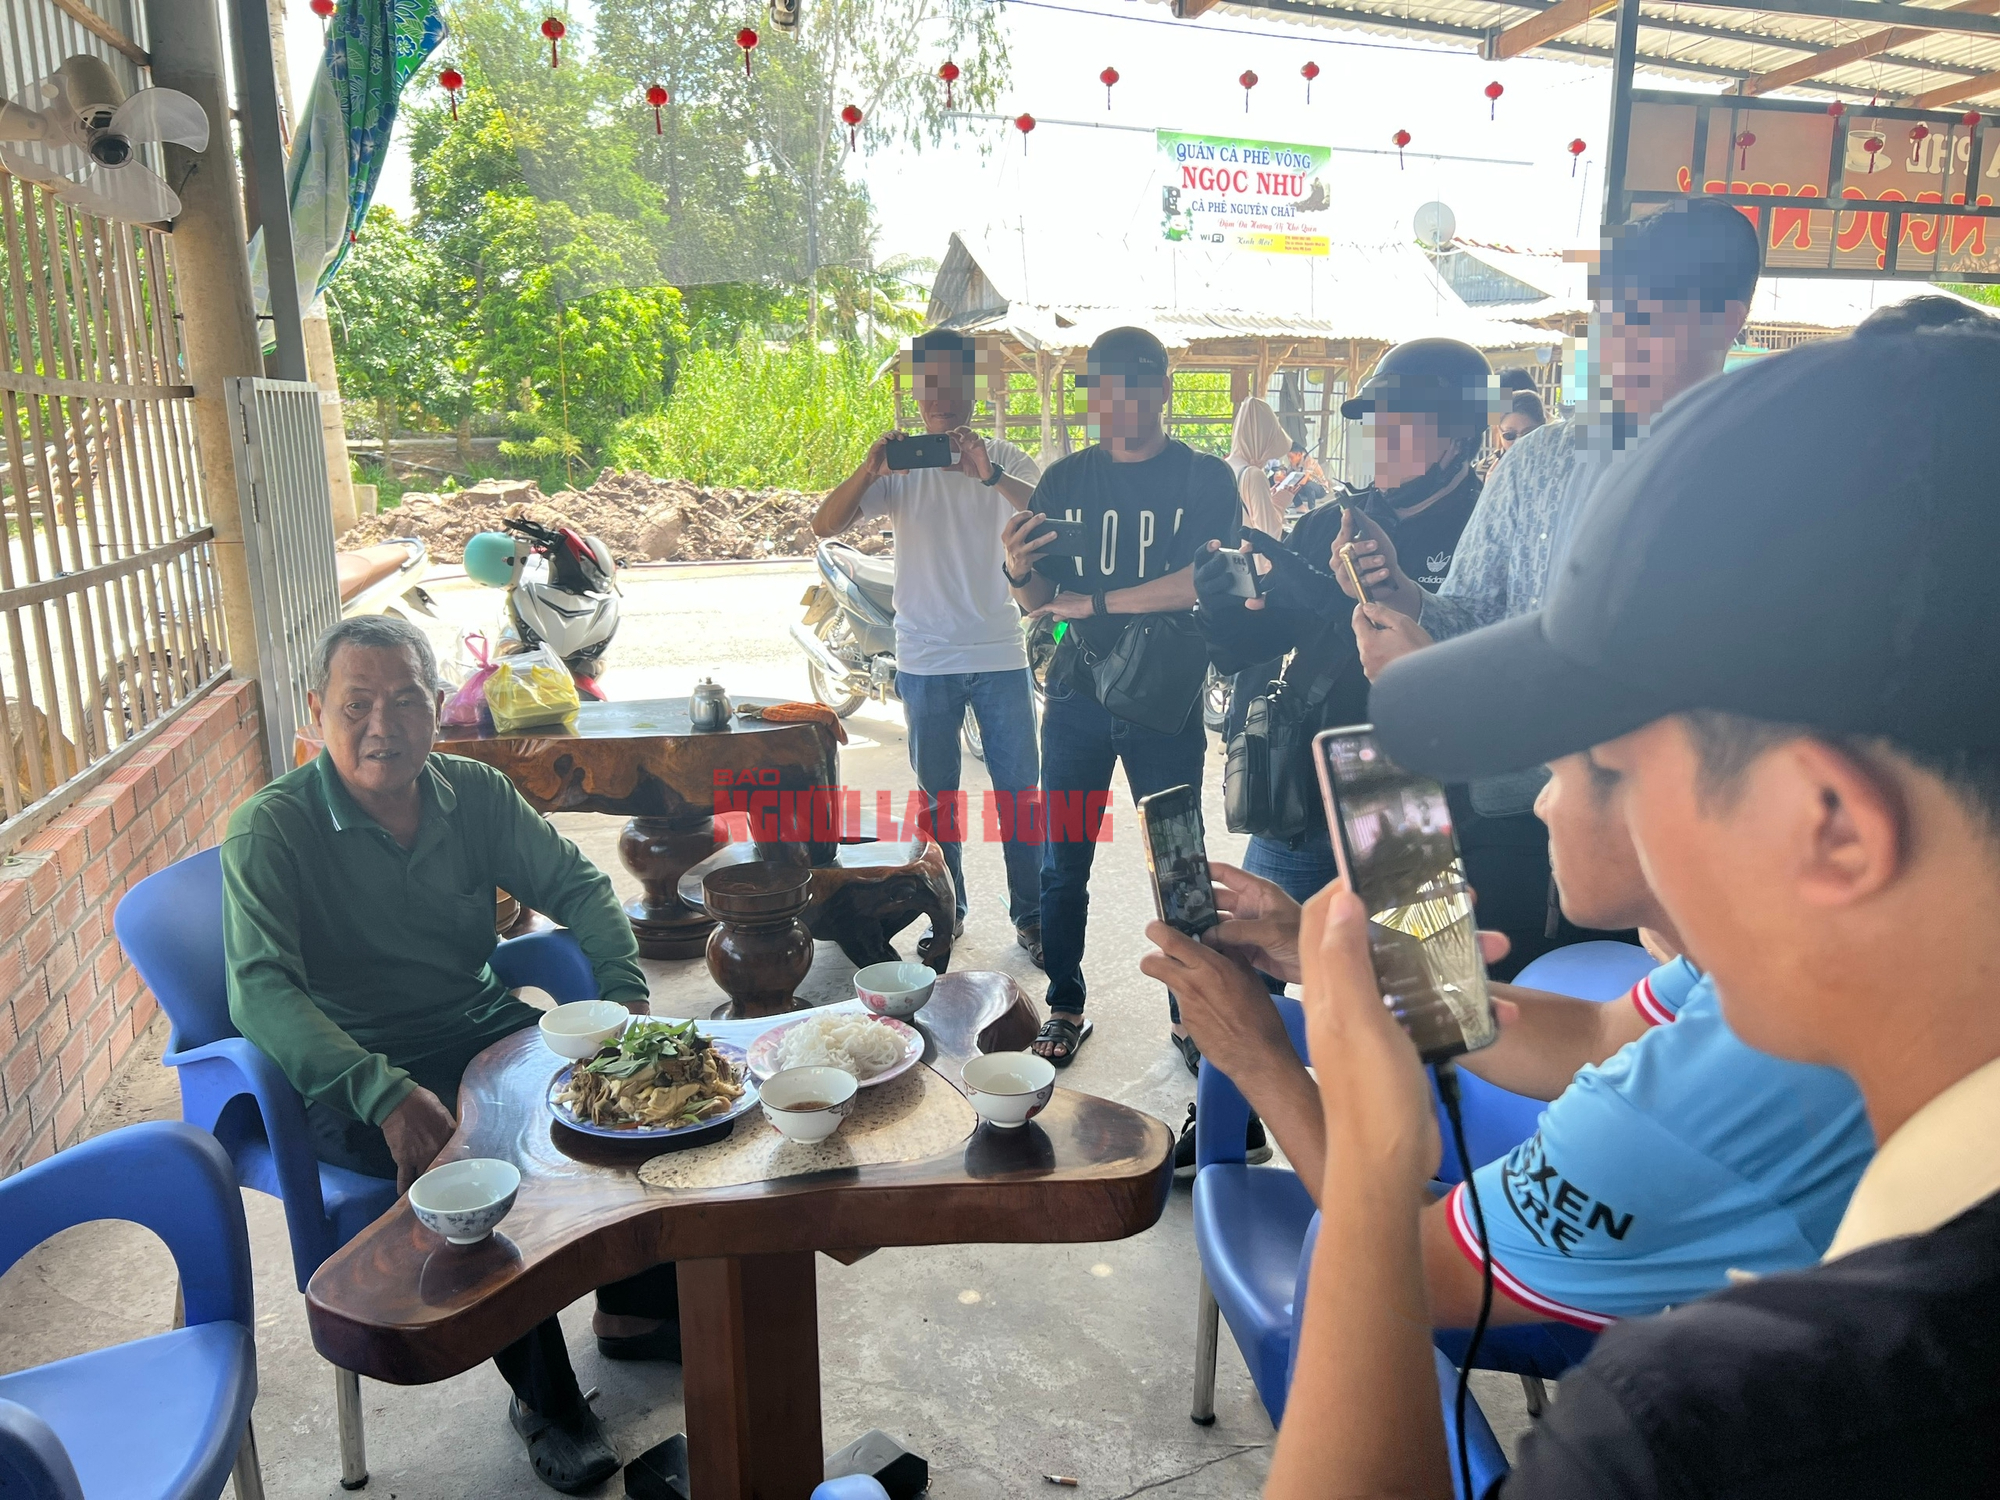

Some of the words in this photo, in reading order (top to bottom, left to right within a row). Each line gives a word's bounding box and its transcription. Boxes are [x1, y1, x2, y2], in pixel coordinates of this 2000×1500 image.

[1176, 141, 1215, 162] QUÁN
[1219, 145, 1239, 163] CÀ
[1243, 148, 1271, 166] PHÊ
[1181, 166, 1249, 197] NGỌC
[1256, 172, 1306, 197] NHƯ
[1191, 198, 1205, 212] CÀ
[1208, 200, 1228, 213] PHÊ
[1230, 202, 1269, 216] NGUYÊN
[1065, 508, 1184, 578] OP
[1523, 1138, 1634, 1241] XEN
